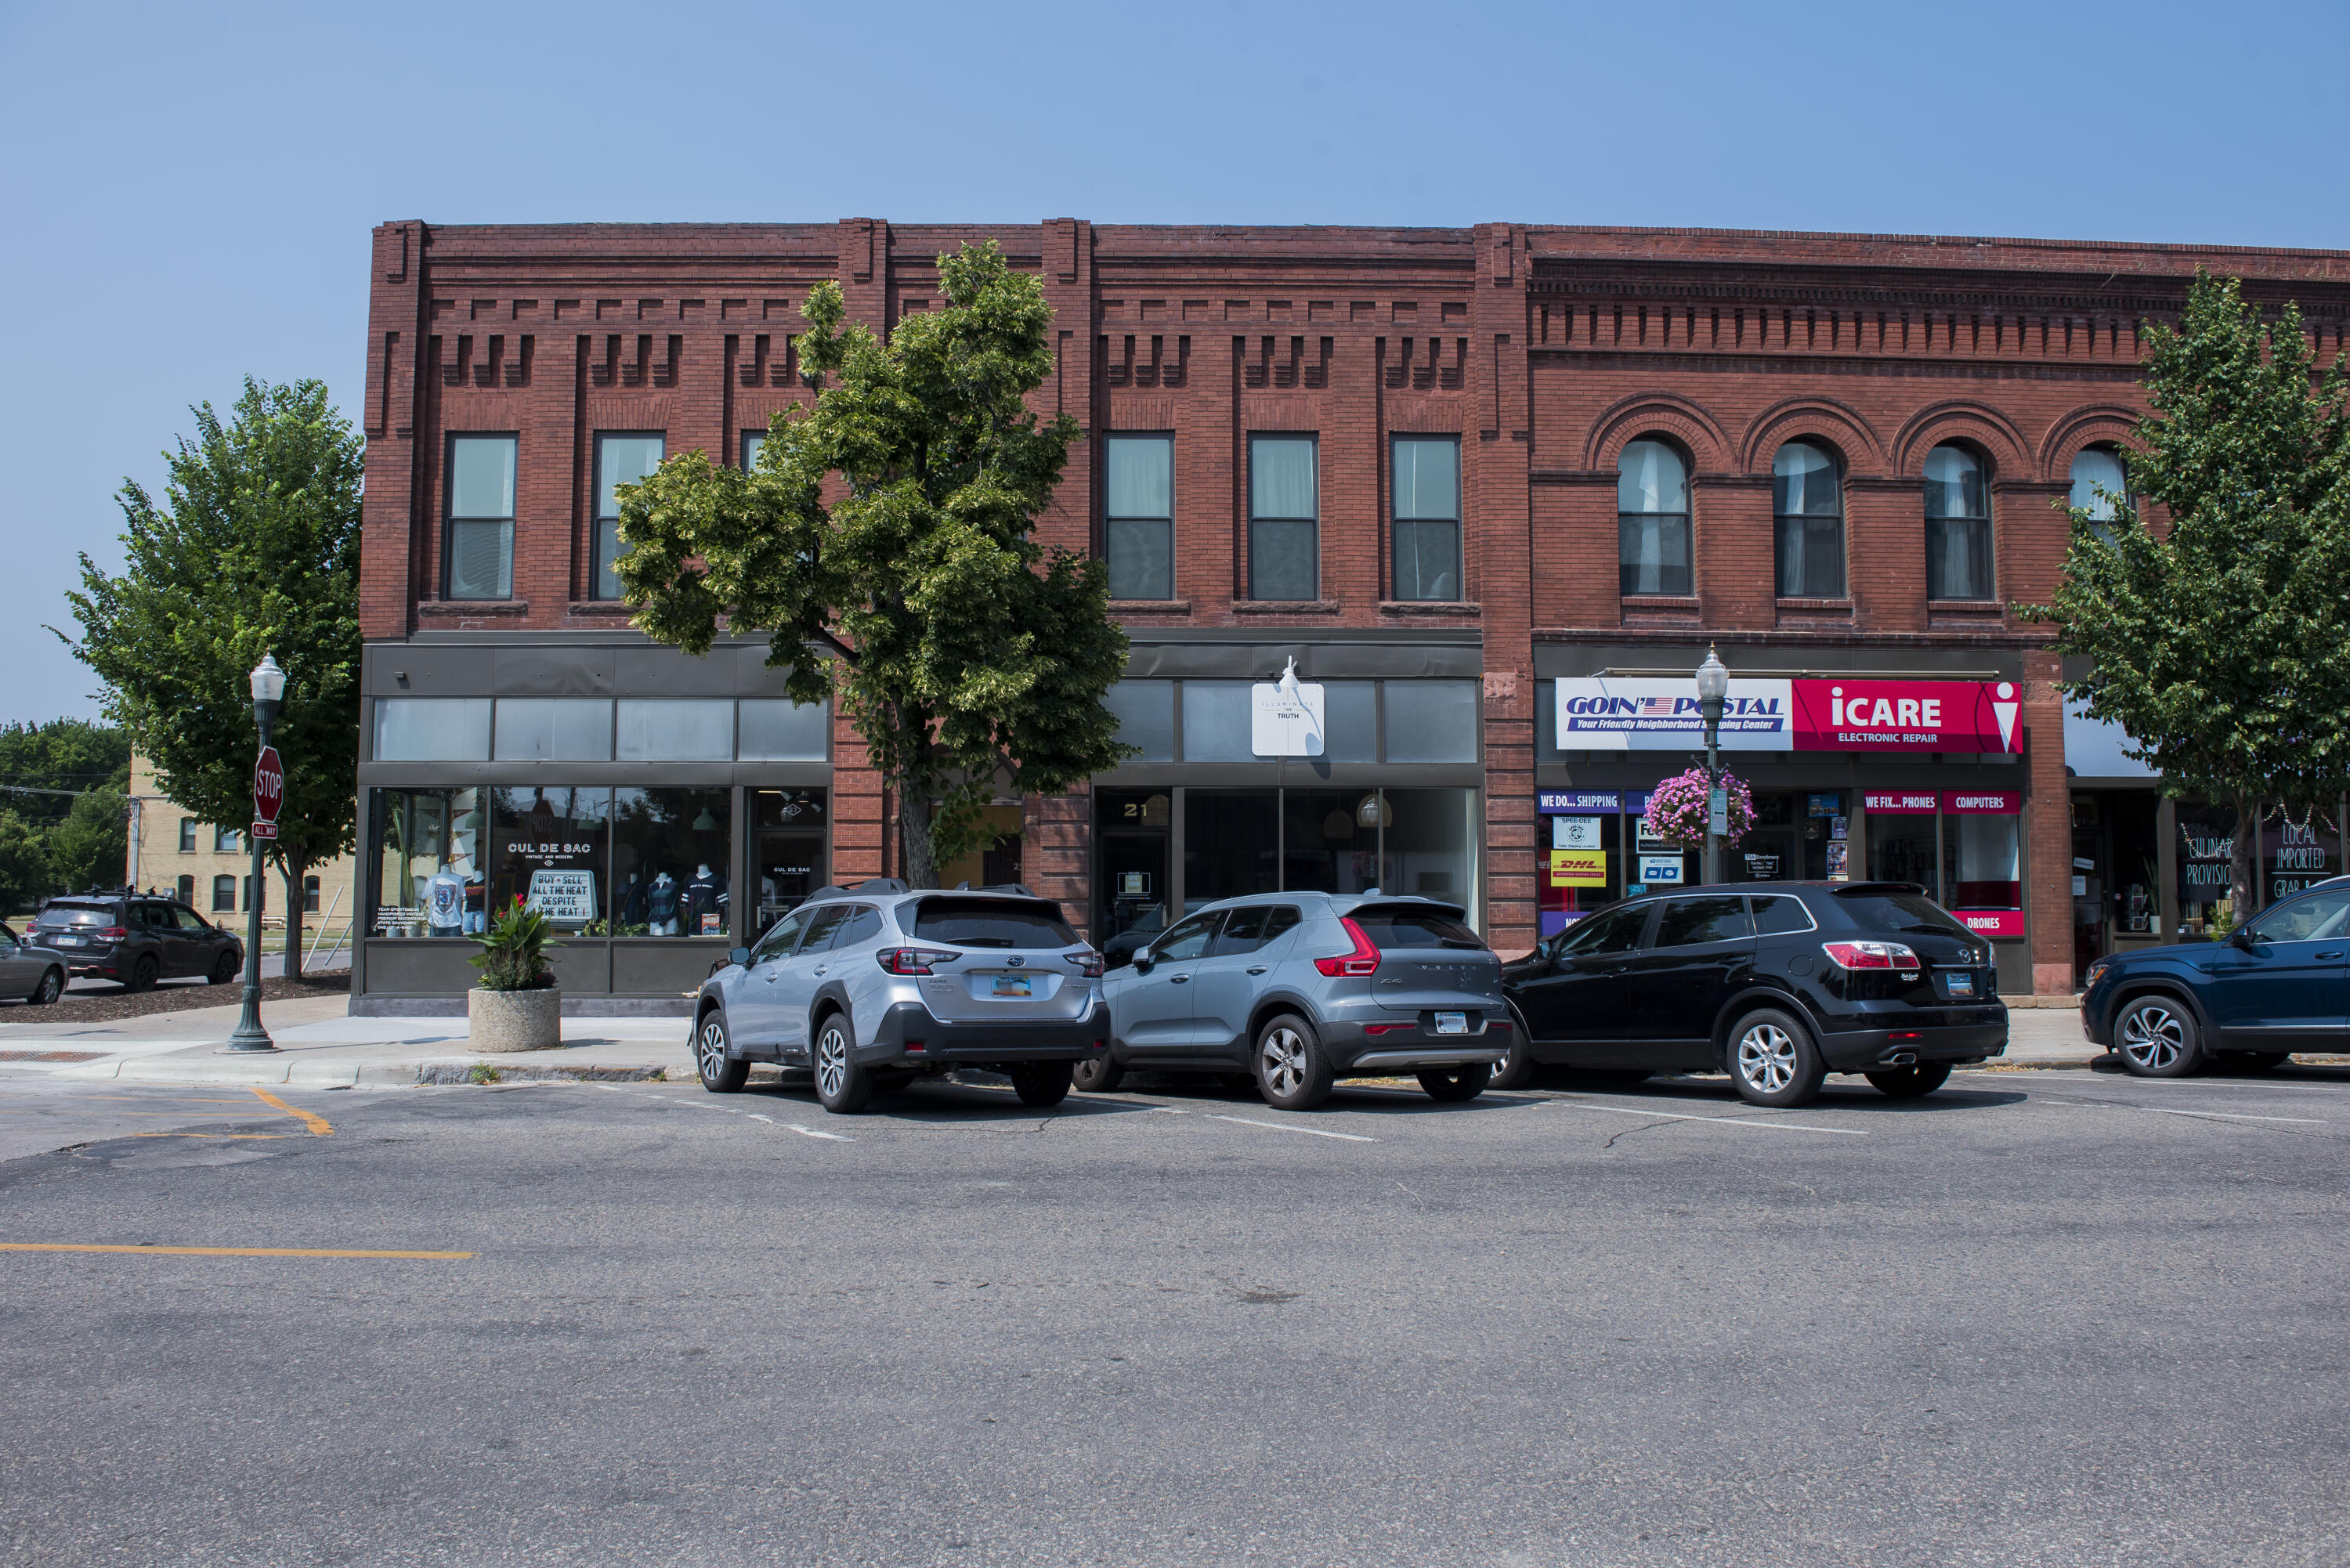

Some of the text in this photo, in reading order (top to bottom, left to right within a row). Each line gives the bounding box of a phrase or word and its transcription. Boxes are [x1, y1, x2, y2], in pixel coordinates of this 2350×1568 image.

[1567, 696, 1645, 714] GOIN'
[1831, 686, 1941, 727] iCARE
[1577, 719, 1595, 729] Your
[1598, 719, 1635, 730] Friendly
[1636, 720, 1700, 730] Neighborhood
[1838, 732, 1937, 742] ELECTRONIC REPAIR
[257, 768, 282, 799] STOP
[1540, 795, 1618, 807] WE DO... SHIPPING
[1865, 797, 1935, 808] WE FIX... PHONES
[1956, 797, 2004, 808] COMPUTERS
[1124, 804, 1147, 816] 21
[255, 826, 277, 836] ALL WAY
[2283, 824, 2318, 844] LOCAL
[508, 844, 591, 853] CUL DE SAC
[2189, 836, 2232, 858] CULINAR
[2276, 847, 2325, 869] IMPORTED
[2187, 864, 2232, 885] PROVISIO
[533, 886, 547, 894] ALL
[566, 887, 588, 895] HEAT
[542, 897, 577, 905] DESPITE
[558, 908, 578, 916] HEAT
[1967, 917, 2000, 929] DRONES
